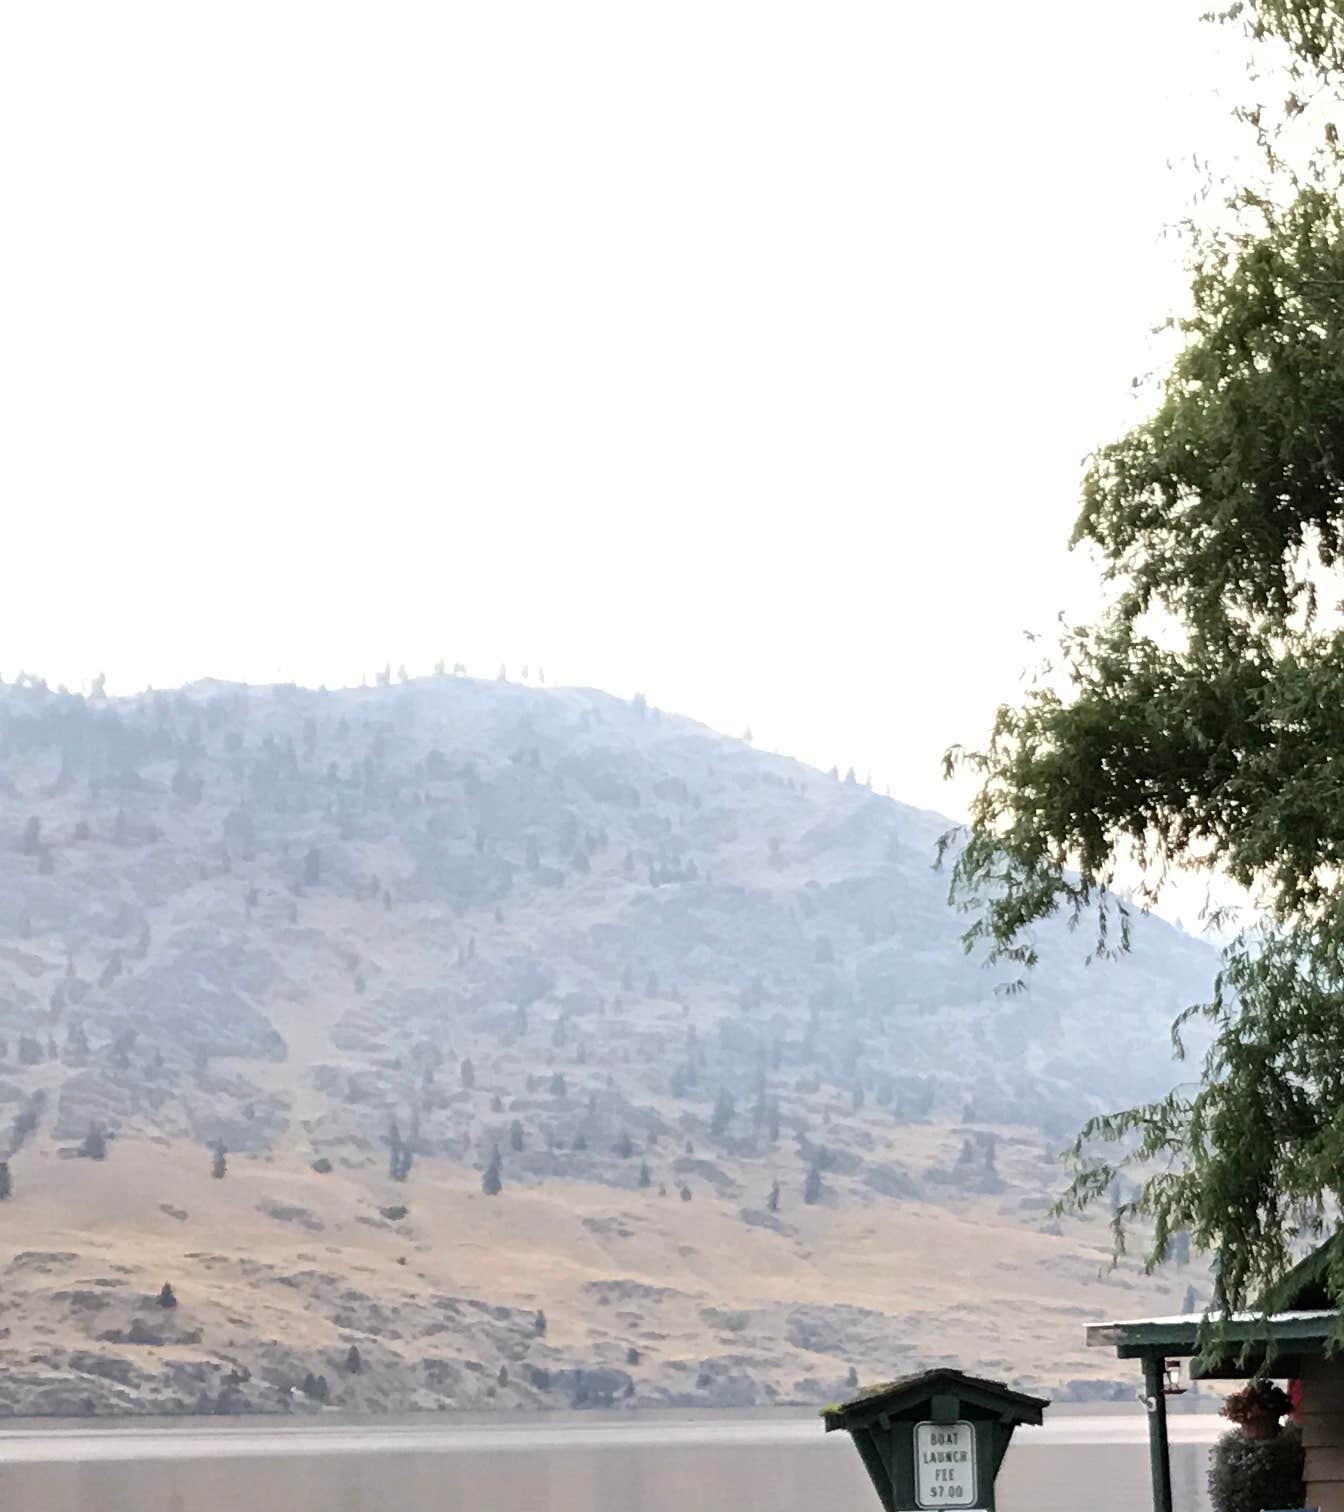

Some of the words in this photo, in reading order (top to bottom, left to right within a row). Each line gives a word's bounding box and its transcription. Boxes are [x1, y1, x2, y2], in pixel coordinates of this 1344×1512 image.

[929, 1432, 960, 1446] BOAT
[922, 1450, 968, 1464] LAUNCH
[935, 1468, 955, 1482] FEE
